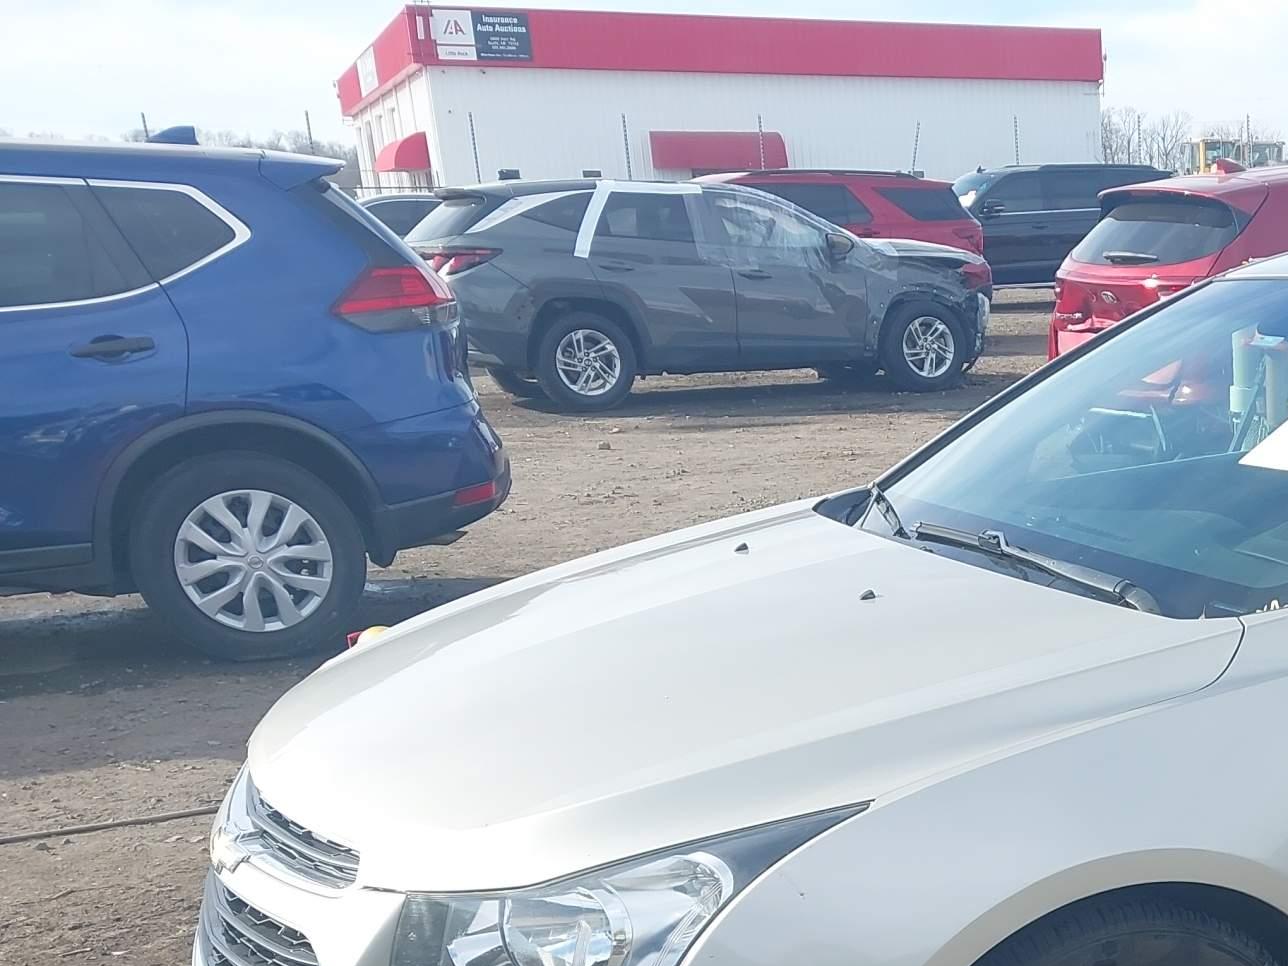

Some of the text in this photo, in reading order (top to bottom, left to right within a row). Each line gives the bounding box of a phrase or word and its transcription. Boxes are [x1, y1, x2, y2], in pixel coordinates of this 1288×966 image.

[482, 14, 518, 24] Insurance
[476, 23, 527, 33] Auto Auctions
